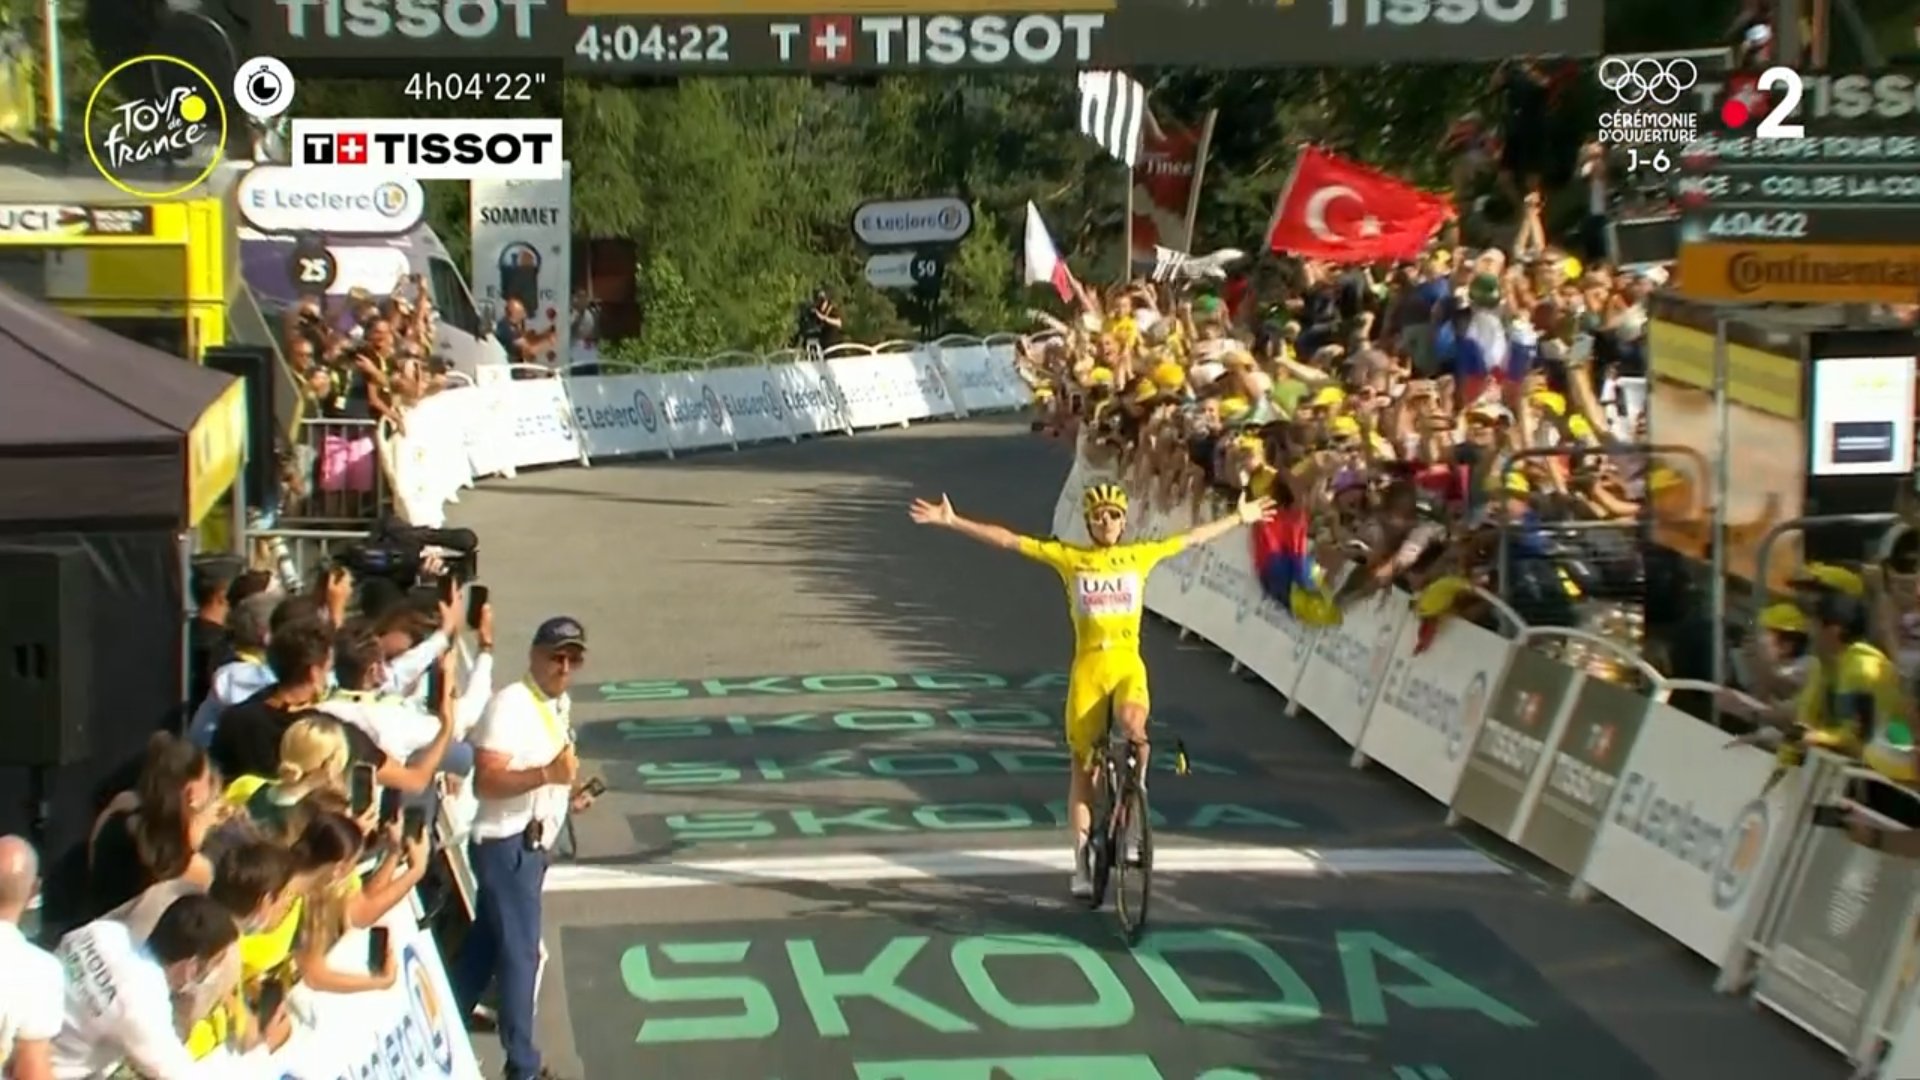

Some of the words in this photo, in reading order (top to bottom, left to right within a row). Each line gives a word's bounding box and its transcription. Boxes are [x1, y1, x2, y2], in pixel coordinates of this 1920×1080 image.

[279, 0, 546, 38] TISSOT
[575, 25, 729, 61] 4:04:22
[861, 15, 1104, 63] TISSOT
[480, 206, 559, 224] SOMMET
[299, 258, 328, 283] 25
[917, 260, 936, 277] 50
